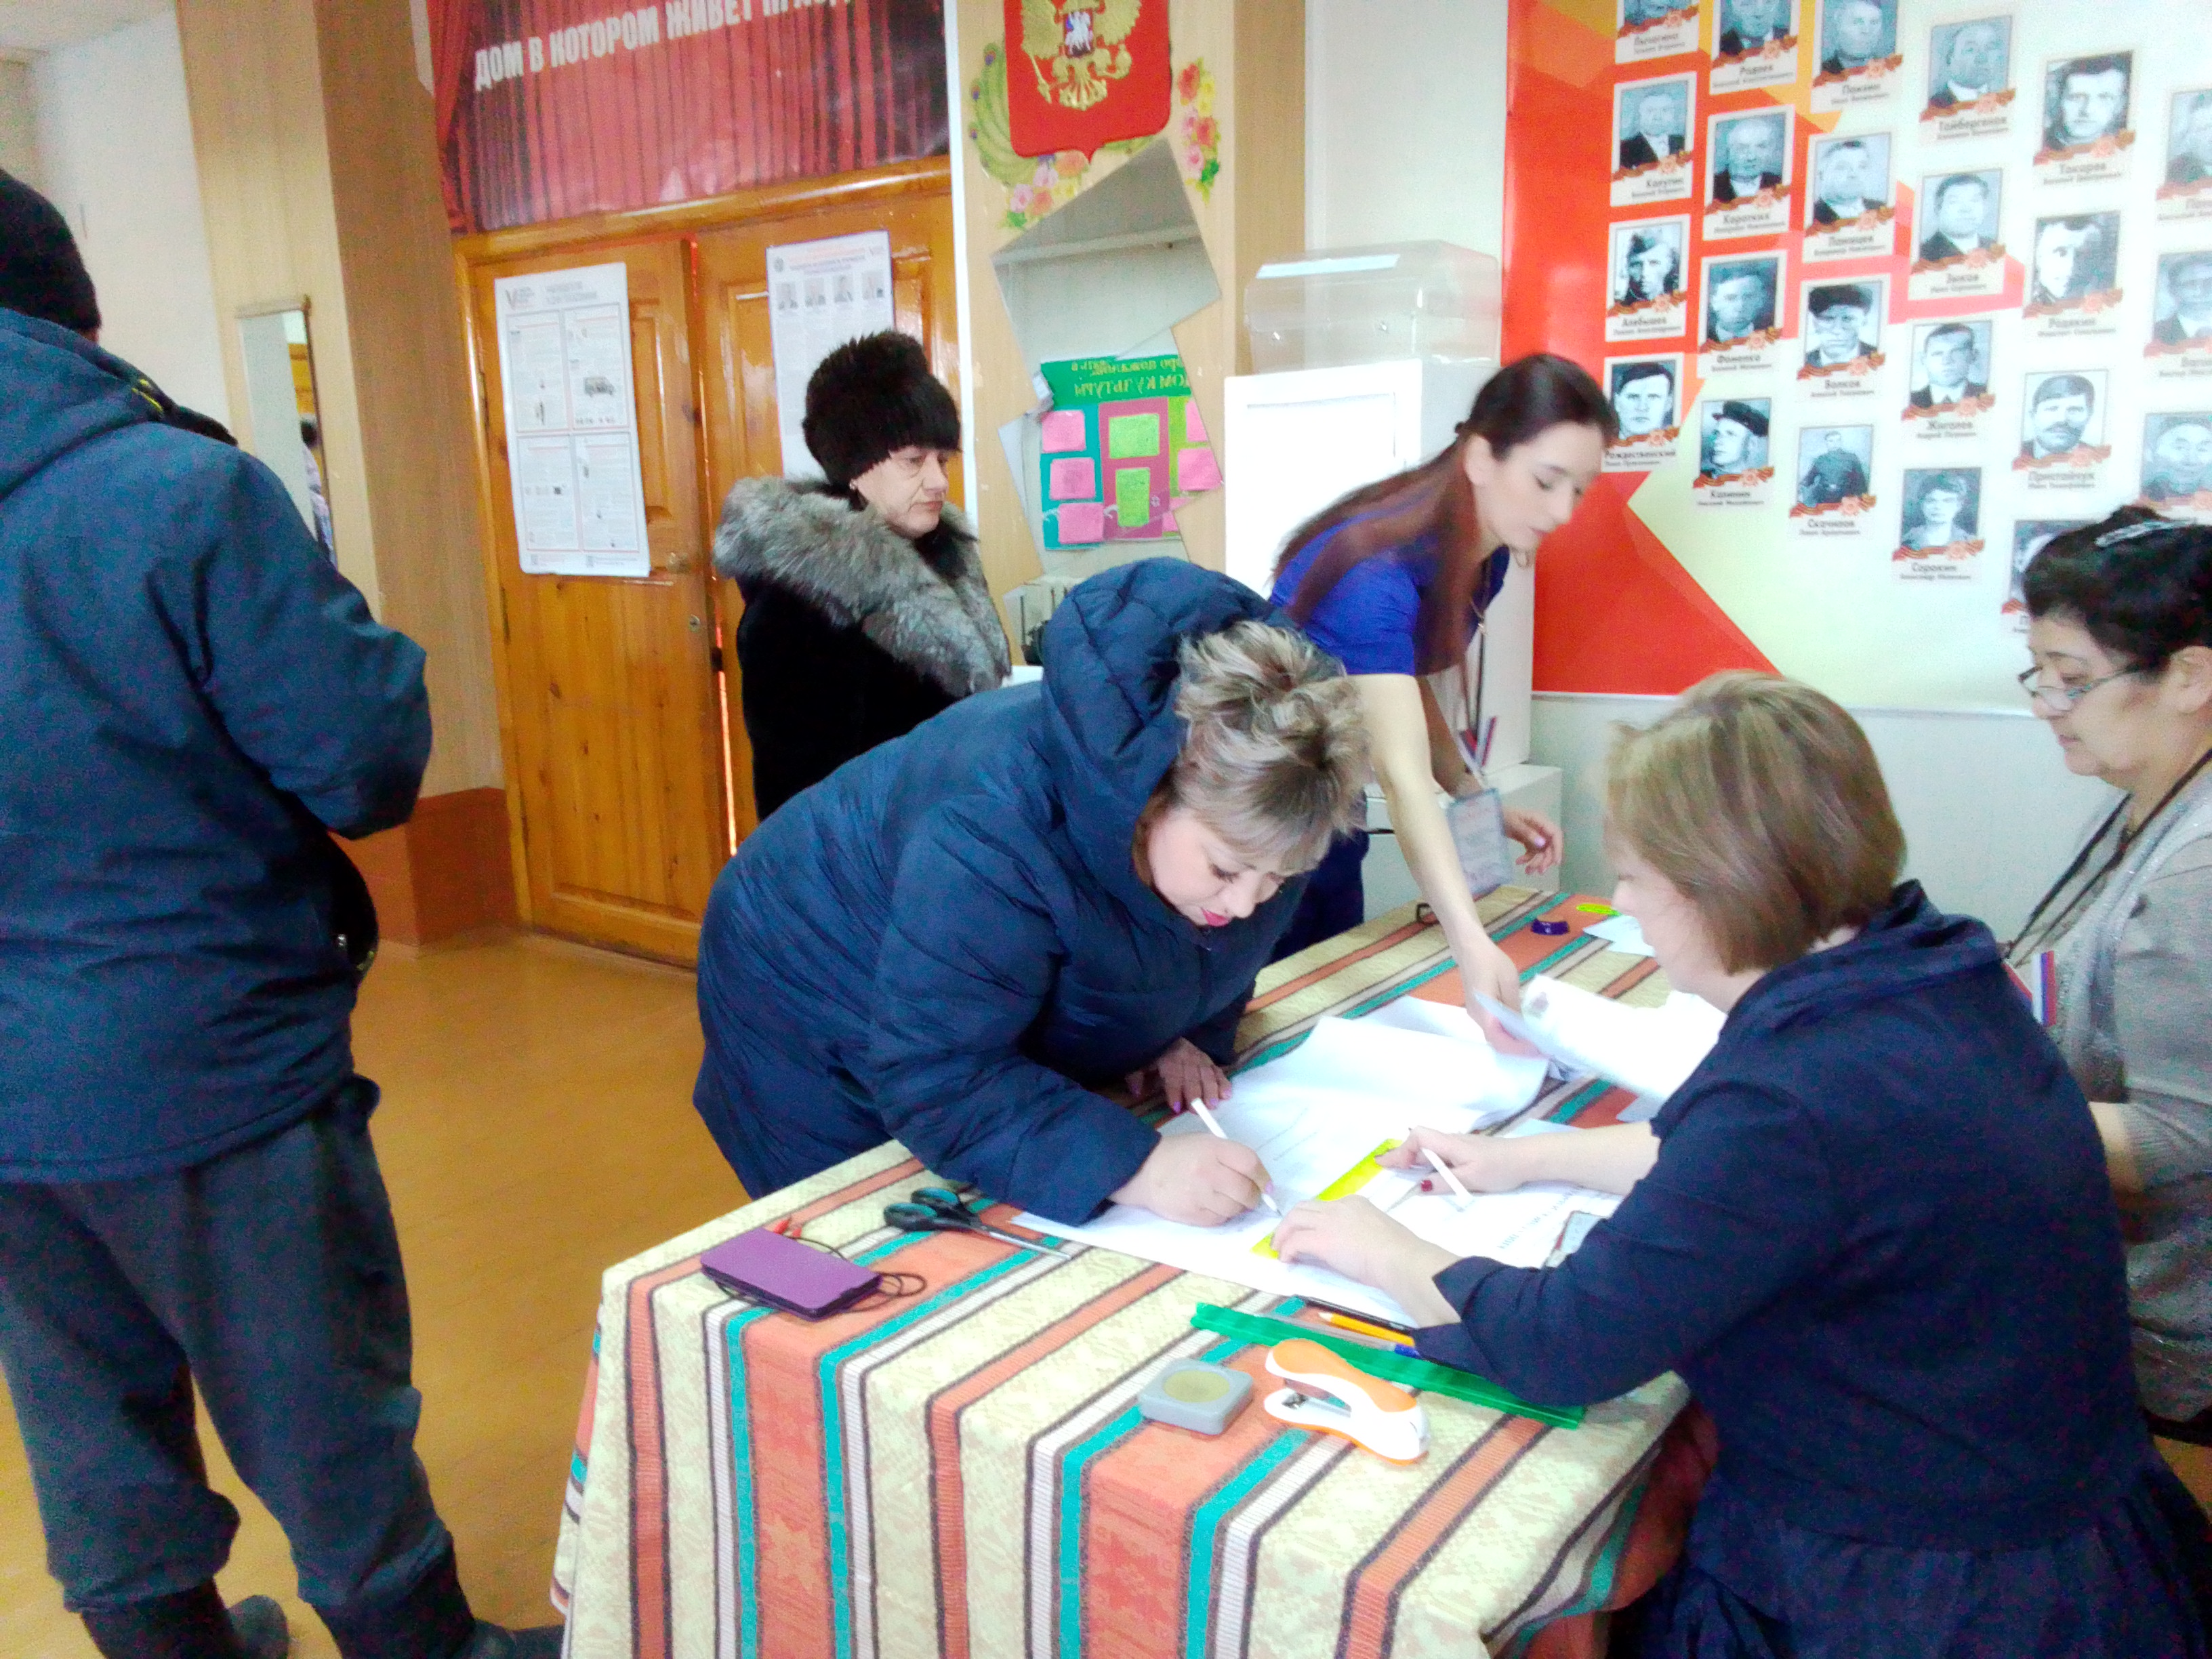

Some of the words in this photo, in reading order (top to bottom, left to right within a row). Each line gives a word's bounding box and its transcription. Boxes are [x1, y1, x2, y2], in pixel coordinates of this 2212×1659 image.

[475, 41, 524, 91] ДОМ
[528, 37, 543, 72] В
[550, 6, 659, 67] КОТОРОМ
